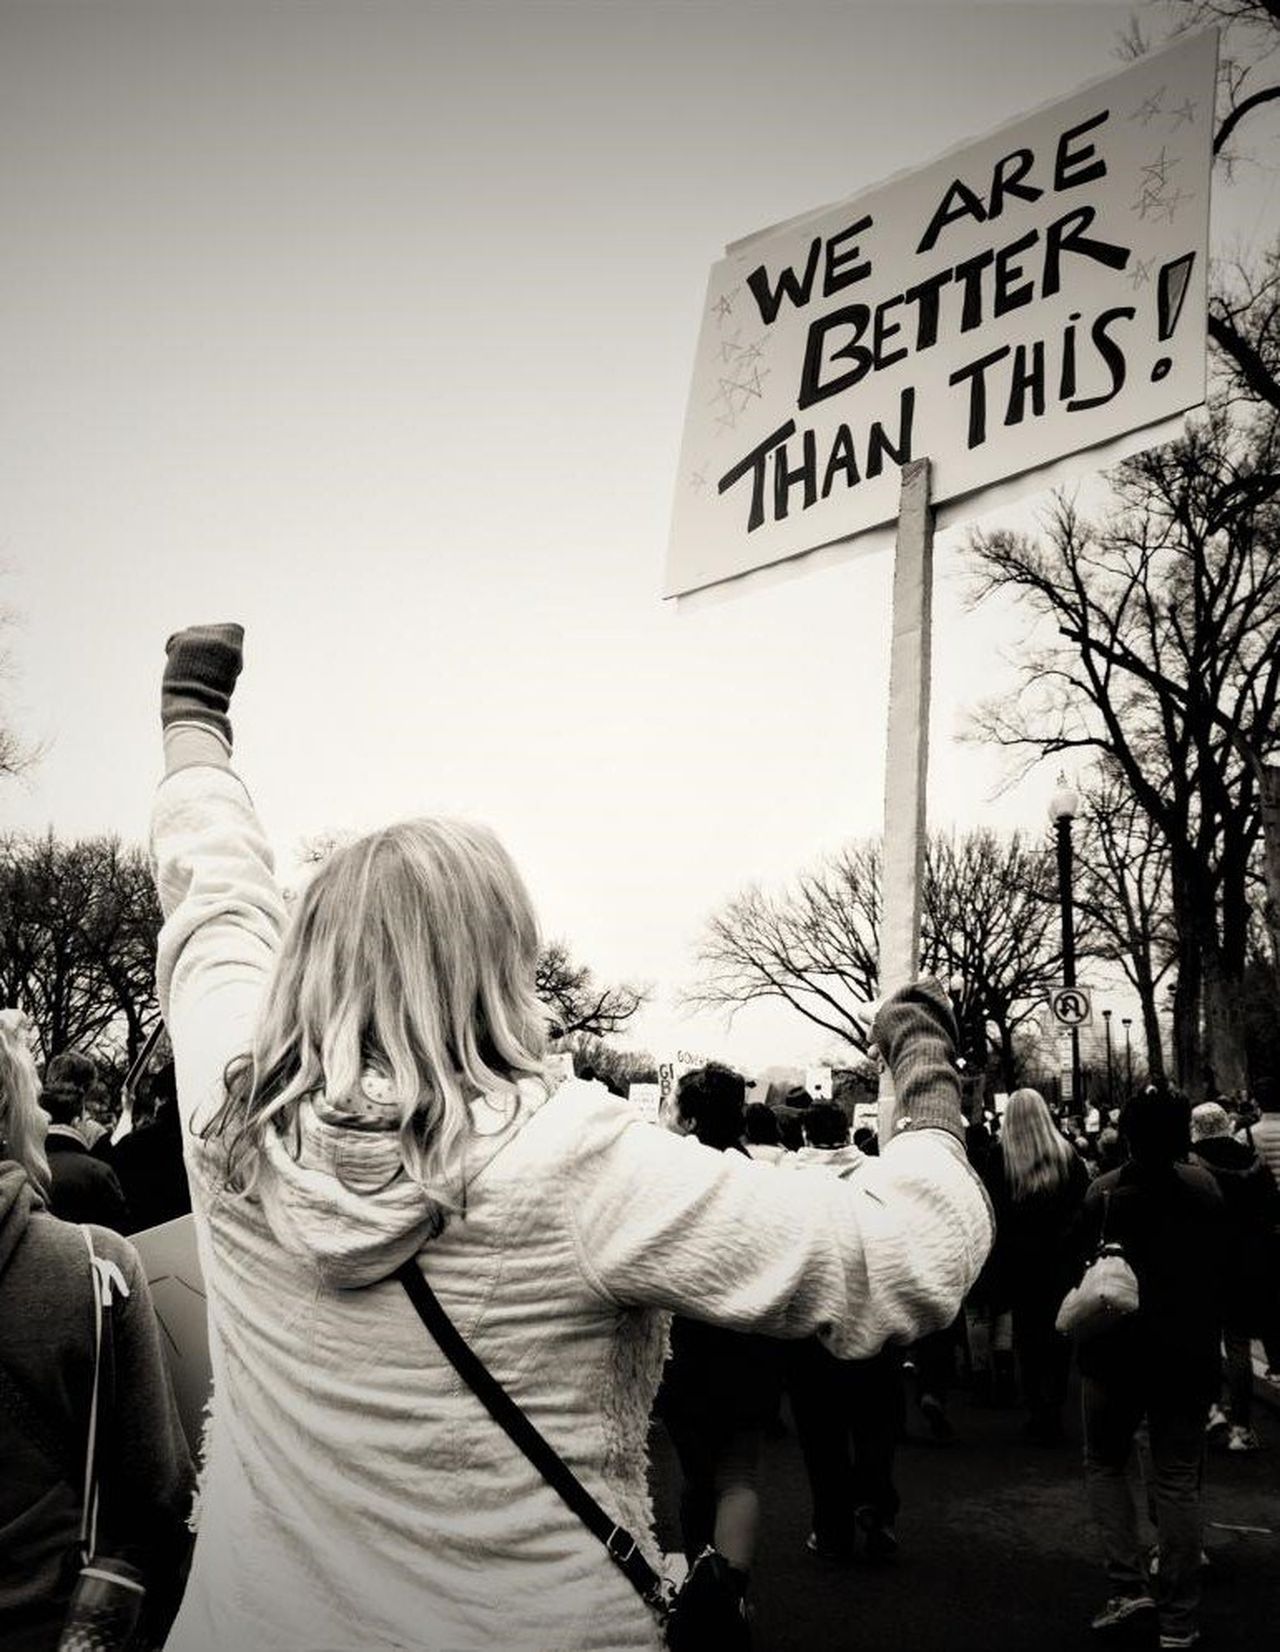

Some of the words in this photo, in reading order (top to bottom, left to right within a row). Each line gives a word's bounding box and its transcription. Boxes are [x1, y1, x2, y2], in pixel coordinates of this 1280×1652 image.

[747, 215, 873, 325] WE
[916, 110, 1110, 254] ARE
[797, 206, 1131, 410] BETTER
[718, 387, 915, 533] THAN
